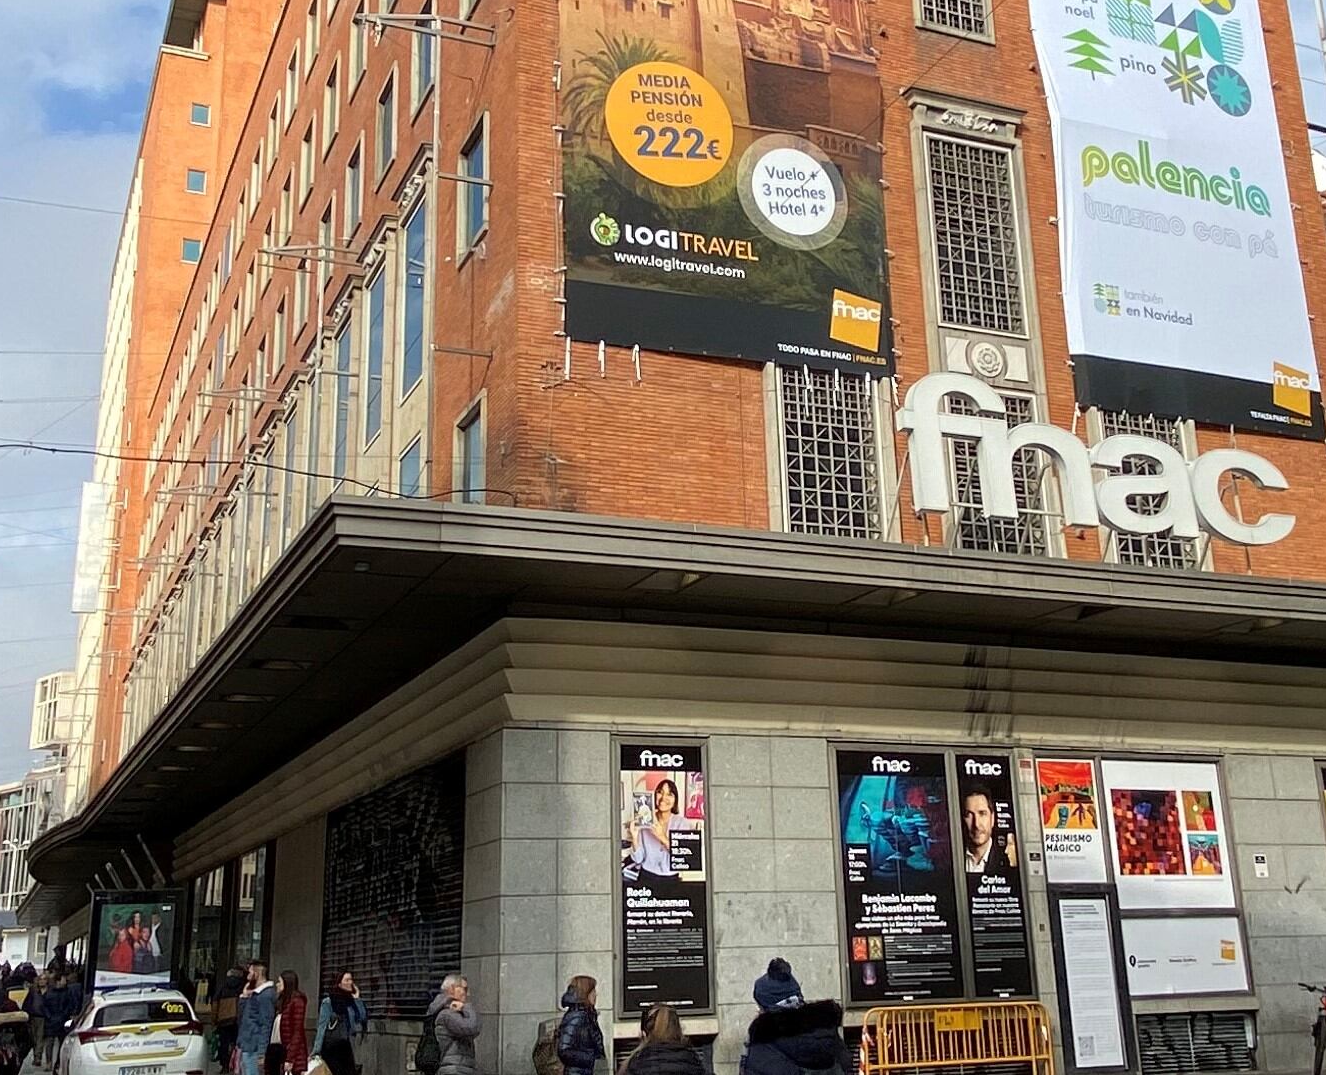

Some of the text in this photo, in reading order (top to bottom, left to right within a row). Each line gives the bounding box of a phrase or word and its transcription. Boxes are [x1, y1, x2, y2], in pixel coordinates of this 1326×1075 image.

[1064, 5, 1095, 20] noel
[1120, 54, 1157, 76] pino
[637, 73, 691, 90] MEDIA
[630, 89, 703, 108] PENSIÓN
[646, 110, 693, 125] desde
[633, 125, 723, 161] 222€
[765, 165, 806, 182] Vuelo
[1080, 140, 1273, 218] palencia
[762, 183, 826, 201] 3 noches
[768, 200, 806, 217] Hotel
[625, 224, 759, 262] LOGITRAVEL
[1193, 220, 1242, 250] con
[614, 251, 746, 279] www.logitravel.com
[1124, 288, 1164, 305] también
[832, 299, 882, 323] fnac
[1126, 307, 1194, 326] en Navidad
[777, 343, 800, 355] TODO
[800, 347, 820, 358] PASA
[820, 350, 832, 359] EN
[832, 351, 853, 362] FNAC
[1274, 370, 1311, 390] fnac
[896, 371, 1297, 546] fnac
[640, 750, 683, 767] fnac
[872, 756, 910, 772] fnac
[965, 760, 1002, 776] fnac
[1045, 833, 1093, 844] PESIMISMO
[1046, 842, 1082, 852] MÁGICO
[981, 875, 1006, 884] Carlos
[978, 885, 1011, 894] del Amor
[865, 906, 871, 915] y
[166, 1003, 185, 1014] 092
